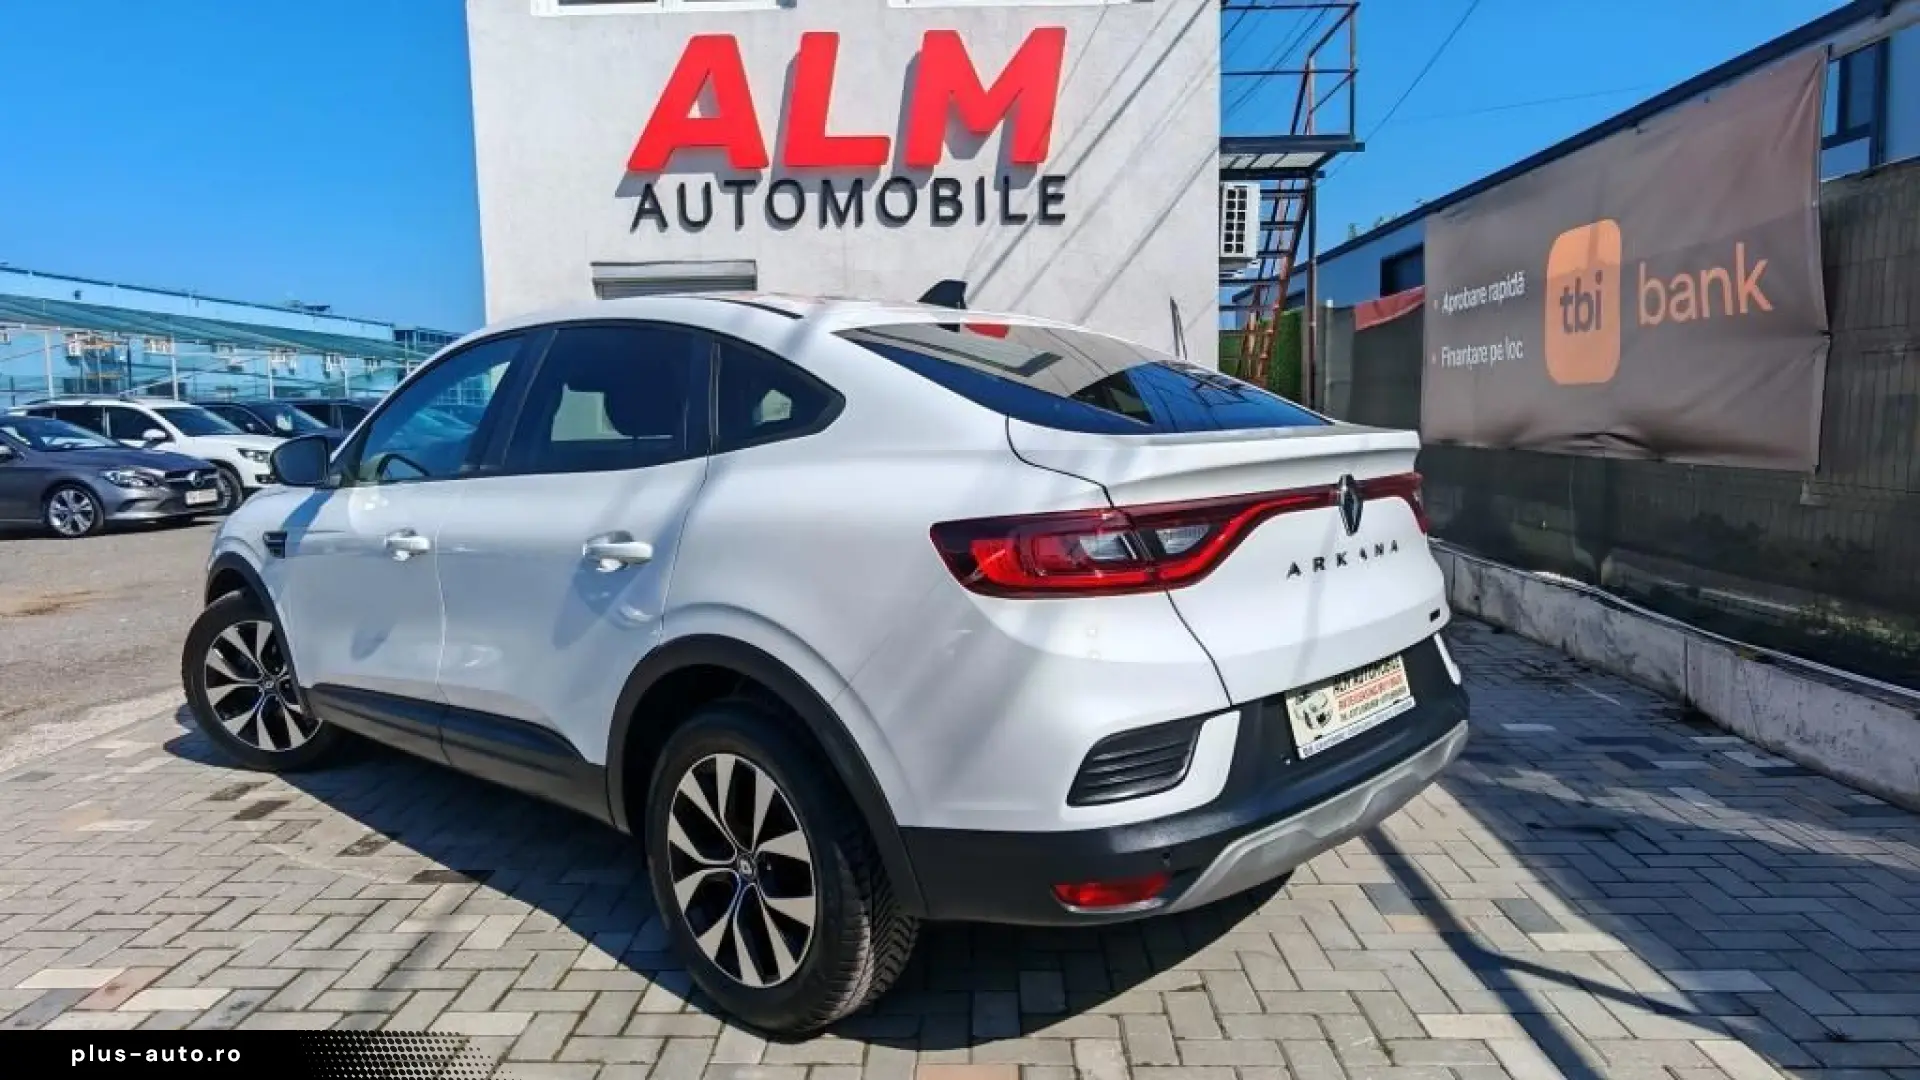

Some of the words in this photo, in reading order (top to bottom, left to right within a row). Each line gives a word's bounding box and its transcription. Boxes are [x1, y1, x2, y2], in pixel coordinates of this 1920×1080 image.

[627, 27, 1067, 171] ALM
[630, 175, 1067, 232] AUTOMOBILE
[1441, 286, 1488, 315] Aprobare
[1560, 269, 1604, 333] tbi
[1638, 241, 1773, 326] bank
[1441, 344, 1488, 371] Finanțare
[1489, 344, 1504, 368] pe
[1504, 335, 1524, 360] loc
[1286, 540, 1399, 579] ARKANA
